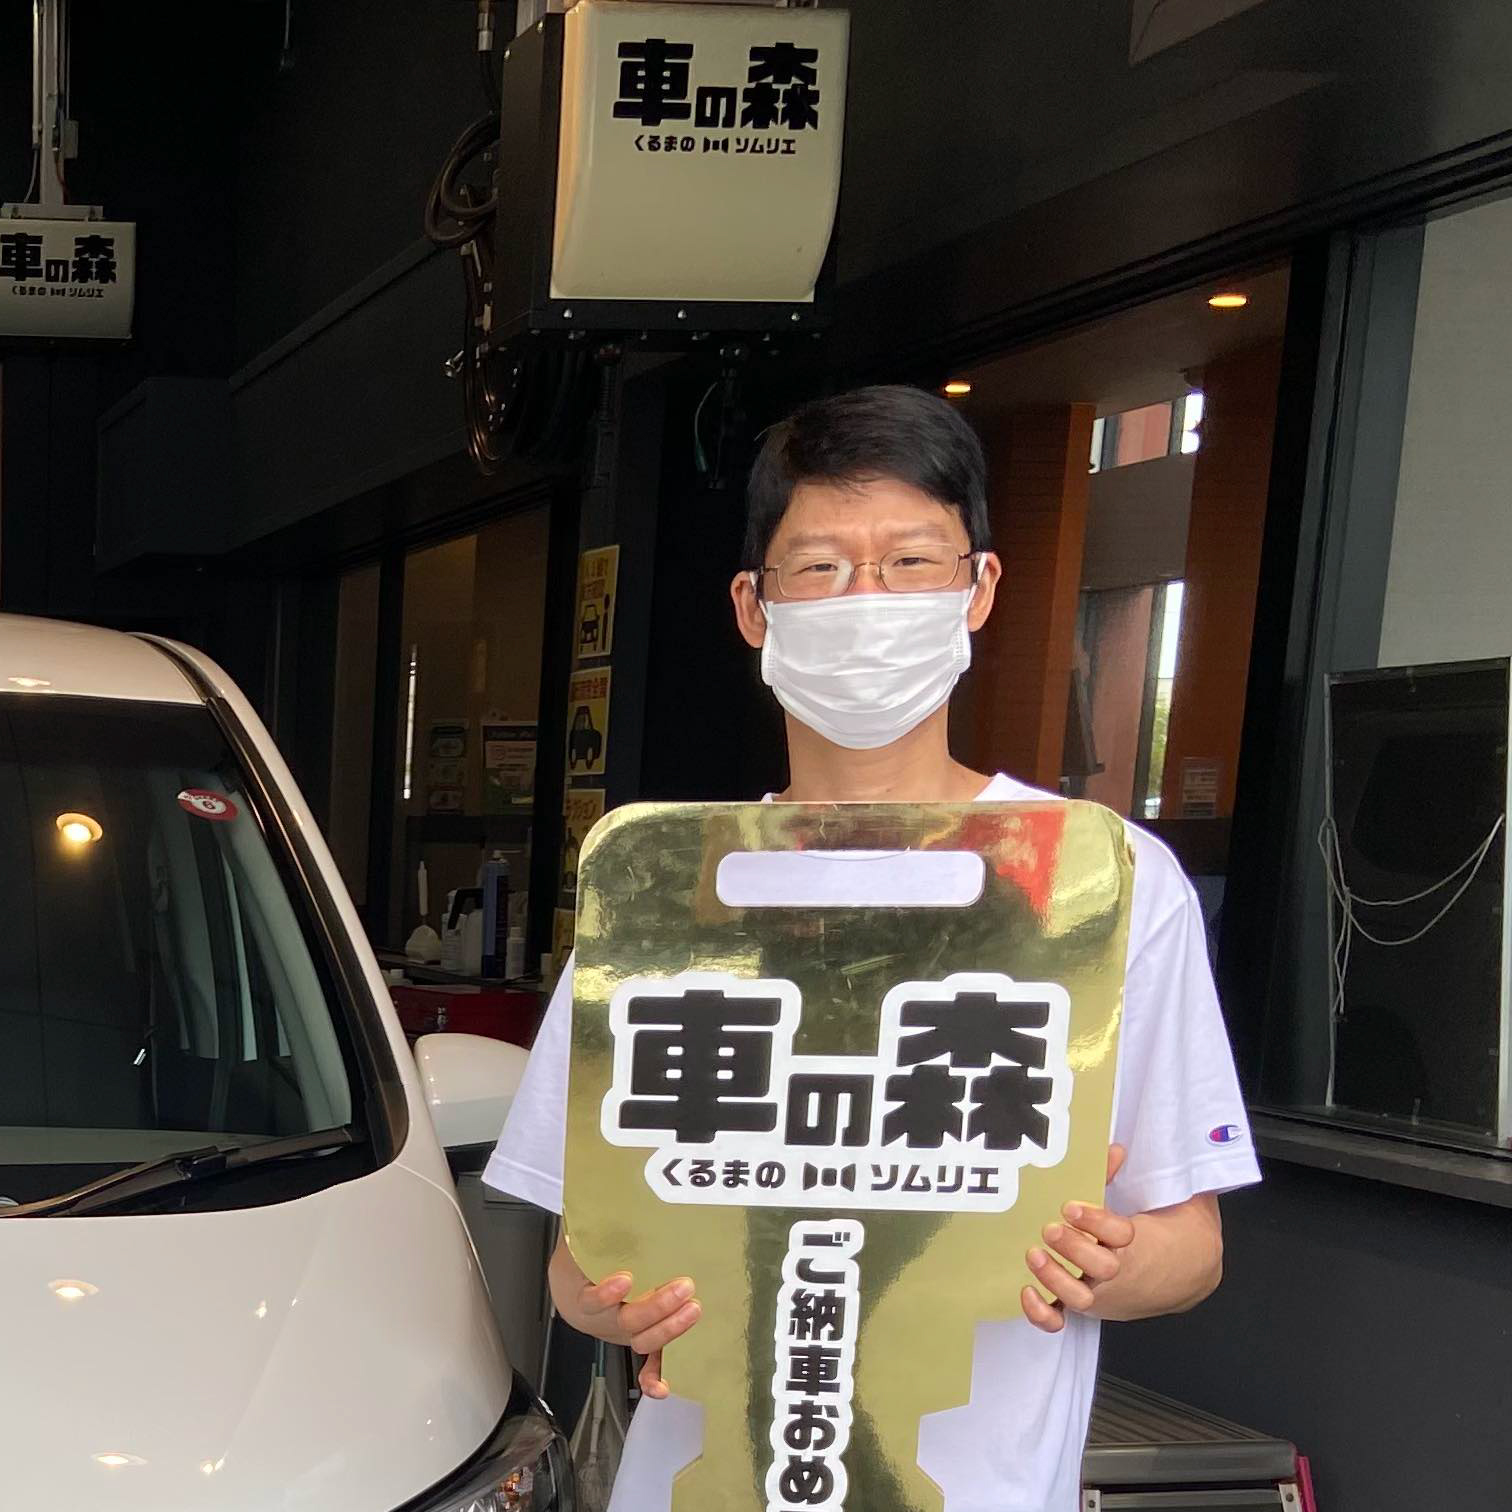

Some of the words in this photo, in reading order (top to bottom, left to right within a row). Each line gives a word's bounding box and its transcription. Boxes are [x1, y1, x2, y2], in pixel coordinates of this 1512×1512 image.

[613, 38, 820, 130] 車の森
[634, 134, 696, 152] くるまの
[735, 137, 796, 155] ソムリエ
[12, 286, 46, 296] くるまの
[69, 288, 104, 298] ソムリエ
[618, 988, 1054, 1151] 車の森
[661, 1158, 787, 1188] くるまの
[871, 1164, 1000, 1194] ソムリエ
